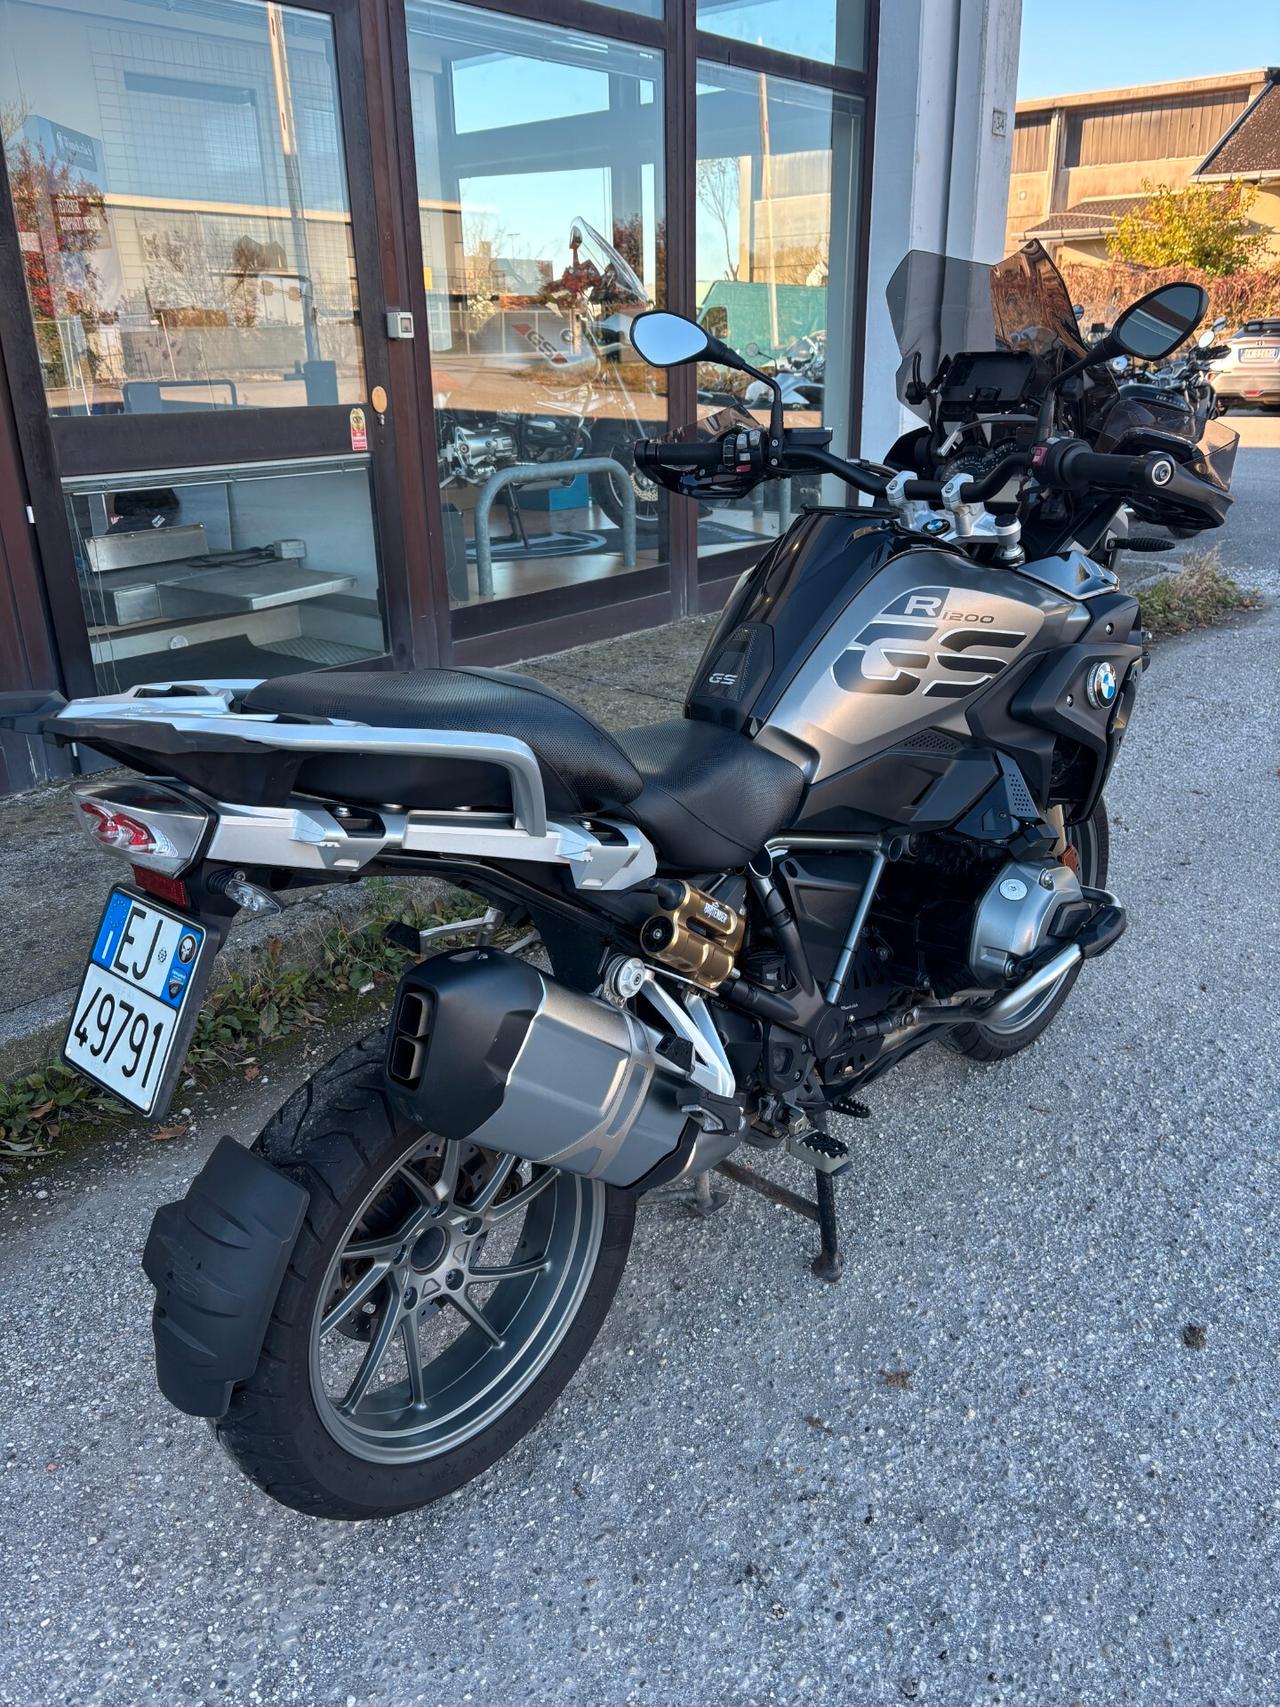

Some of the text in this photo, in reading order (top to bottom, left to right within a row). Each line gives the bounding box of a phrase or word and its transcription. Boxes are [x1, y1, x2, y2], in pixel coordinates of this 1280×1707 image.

[527, 330, 558, 359] GS
[904, 595, 995, 624] R 1200
[709, 672, 738, 685] GS
[830, 620, 1028, 699] GS
[113, 905, 163, 980] EJ
[74, 986, 164, 1089] 49791
